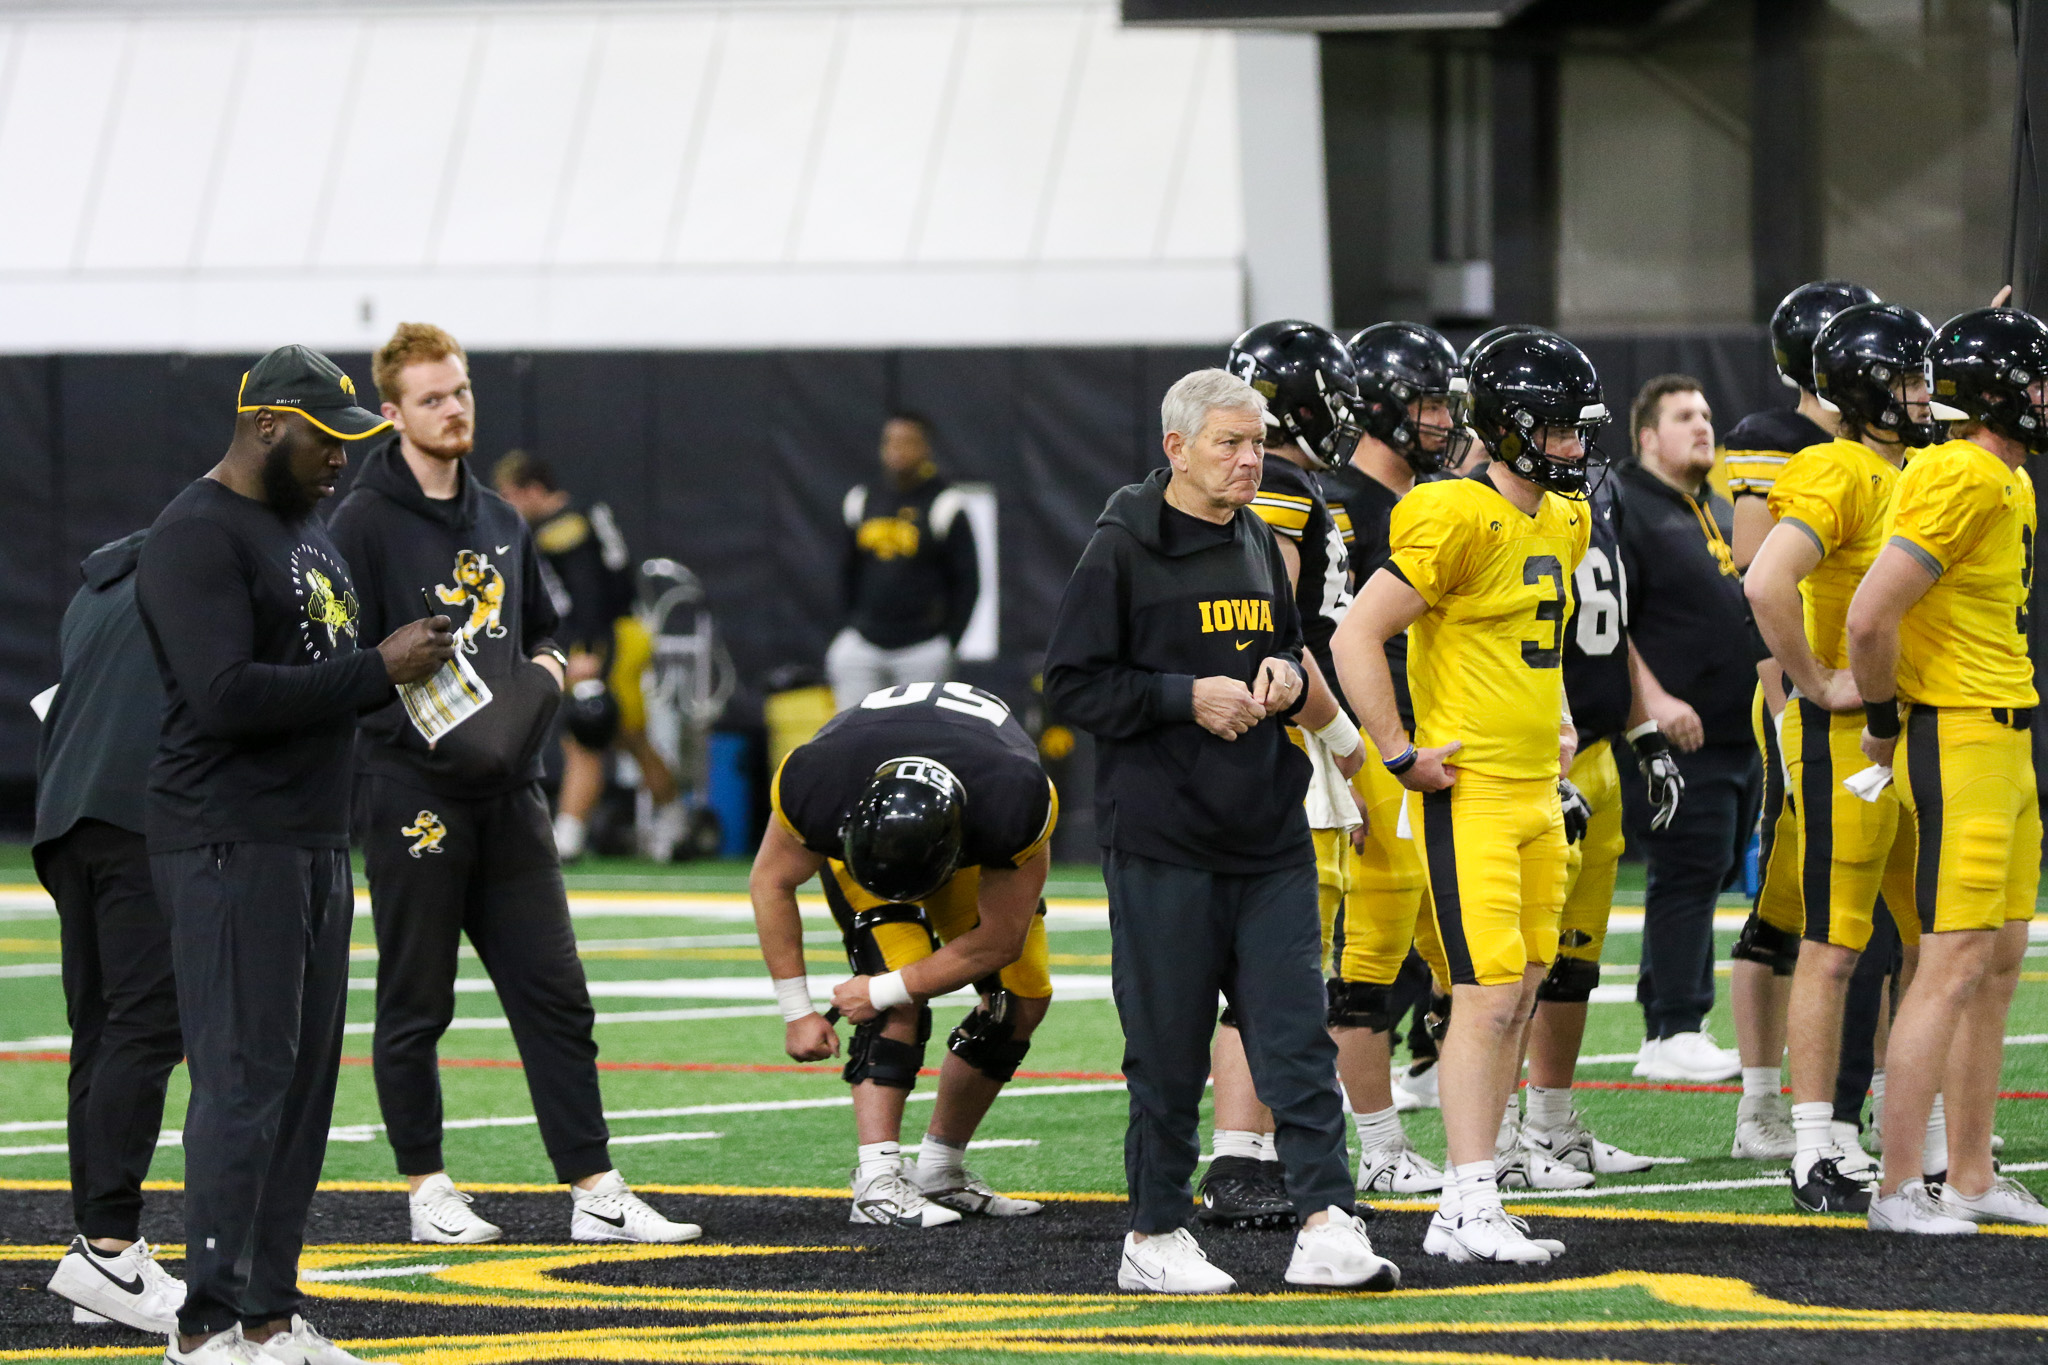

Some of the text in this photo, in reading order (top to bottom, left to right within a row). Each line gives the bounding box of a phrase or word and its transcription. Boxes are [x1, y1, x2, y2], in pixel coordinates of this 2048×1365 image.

[1198, 599, 1274, 633] IOWA
[1521, 554, 1567, 669] 3
[1575, 544, 1628, 656] 6
